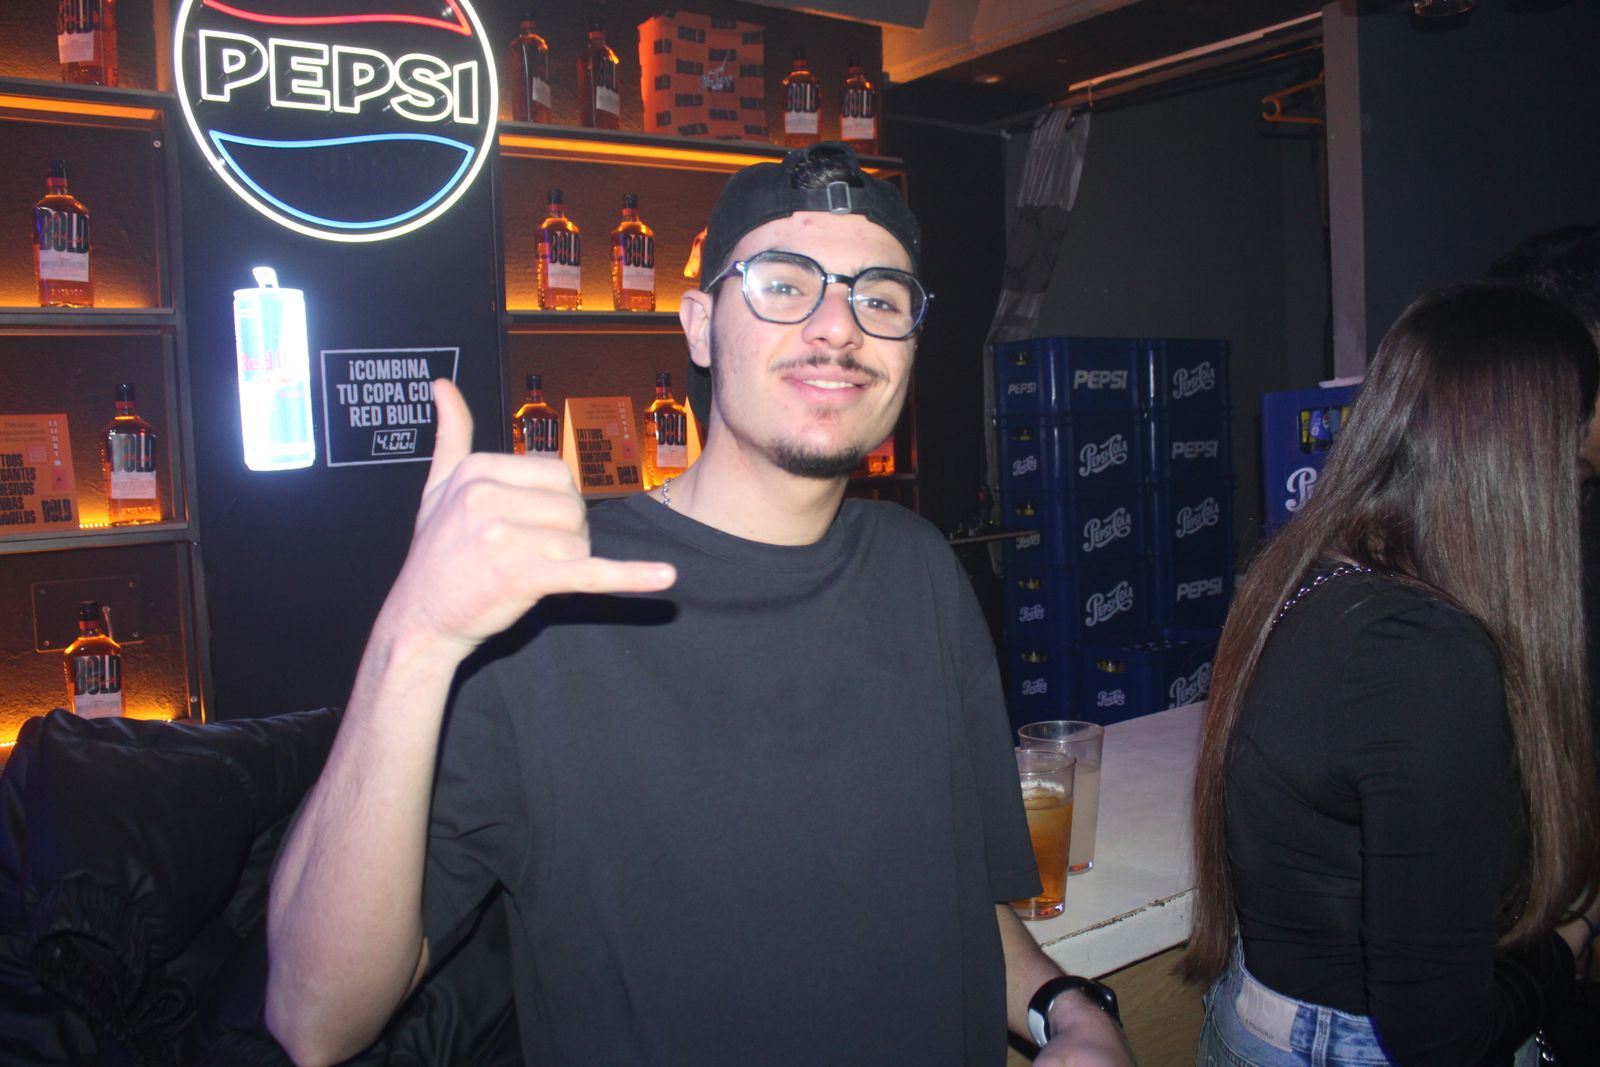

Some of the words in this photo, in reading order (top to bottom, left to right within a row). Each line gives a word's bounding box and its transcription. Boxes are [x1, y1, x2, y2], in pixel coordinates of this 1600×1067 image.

[199, 29, 479, 125] PEPSI
[41, 208, 89, 254] BOLD
[548, 230, 580, 267] BOLD
[623, 233, 654, 269] BOLD
[348, 359, 430, 381] ¡COMBINA
[1073, 369, 1128, 390] PEPSI
[336, 384, 359, 405] TU
[362, 382, 406, 404] COPA
[1008, 382, 1037, 395] PEPSI
[349, 406, 382, 428] RED
[386, 403, 432, 426] BULL!
[525, 417, 559, 452] BOLD
[657, 413, 687, 446] BOLD
[1171, 440, 1219, 460] PEPSI
[1176, 576, 1223, 602] PEPSI
